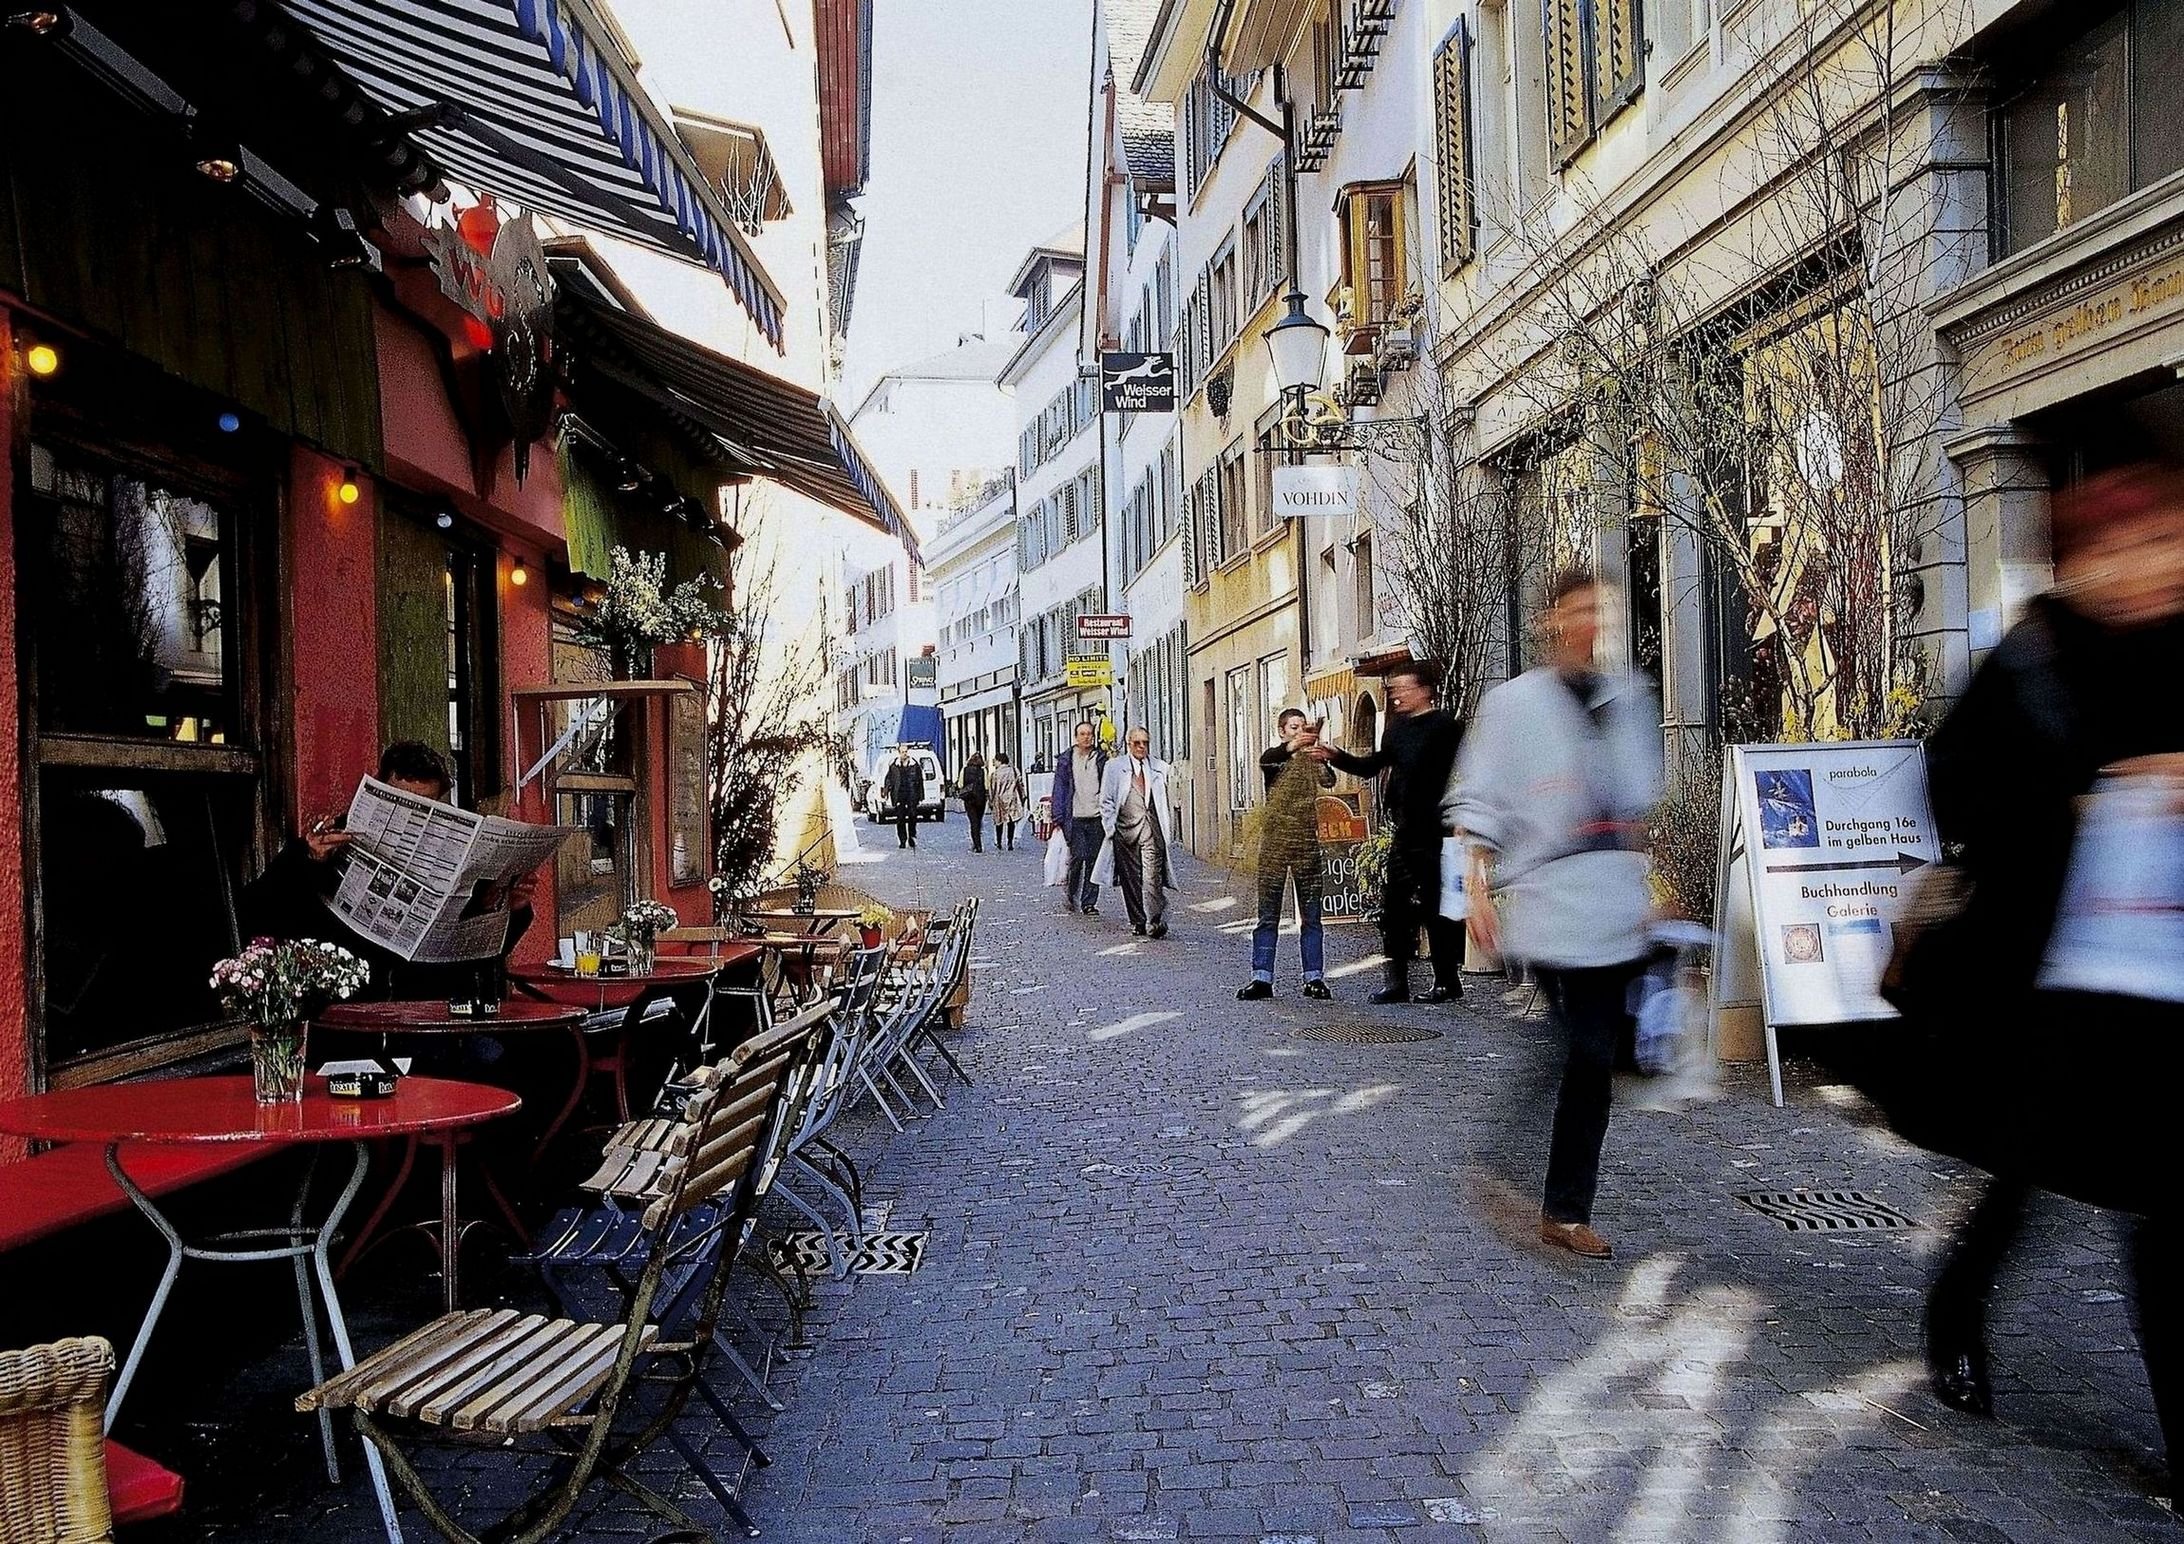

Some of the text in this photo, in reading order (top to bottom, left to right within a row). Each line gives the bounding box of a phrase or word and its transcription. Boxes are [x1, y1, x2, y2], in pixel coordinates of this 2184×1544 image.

[2129, 270, 2184, 312] Hau
[1122, 383, 1173, 397] Weisser
[1114, 395, 1148, 409] Wind
[1282, 491, 1349, 506] VOHDIN
[1083, 618, 1124, 627] Restaurant
[1080, 626, 1129, 637] Weisser Wind
[1068, 655, 1081, 663] NO
[1829, 765, 1878, 782] parabola
[1825, 816, 1917, 833] Durchgang 16e
[1827, 832, 1923, 850] im gelben Haus
[1801, 881, 1899, 899] Buchhandlung
[1826, 903, 1879, 918] Galerie
